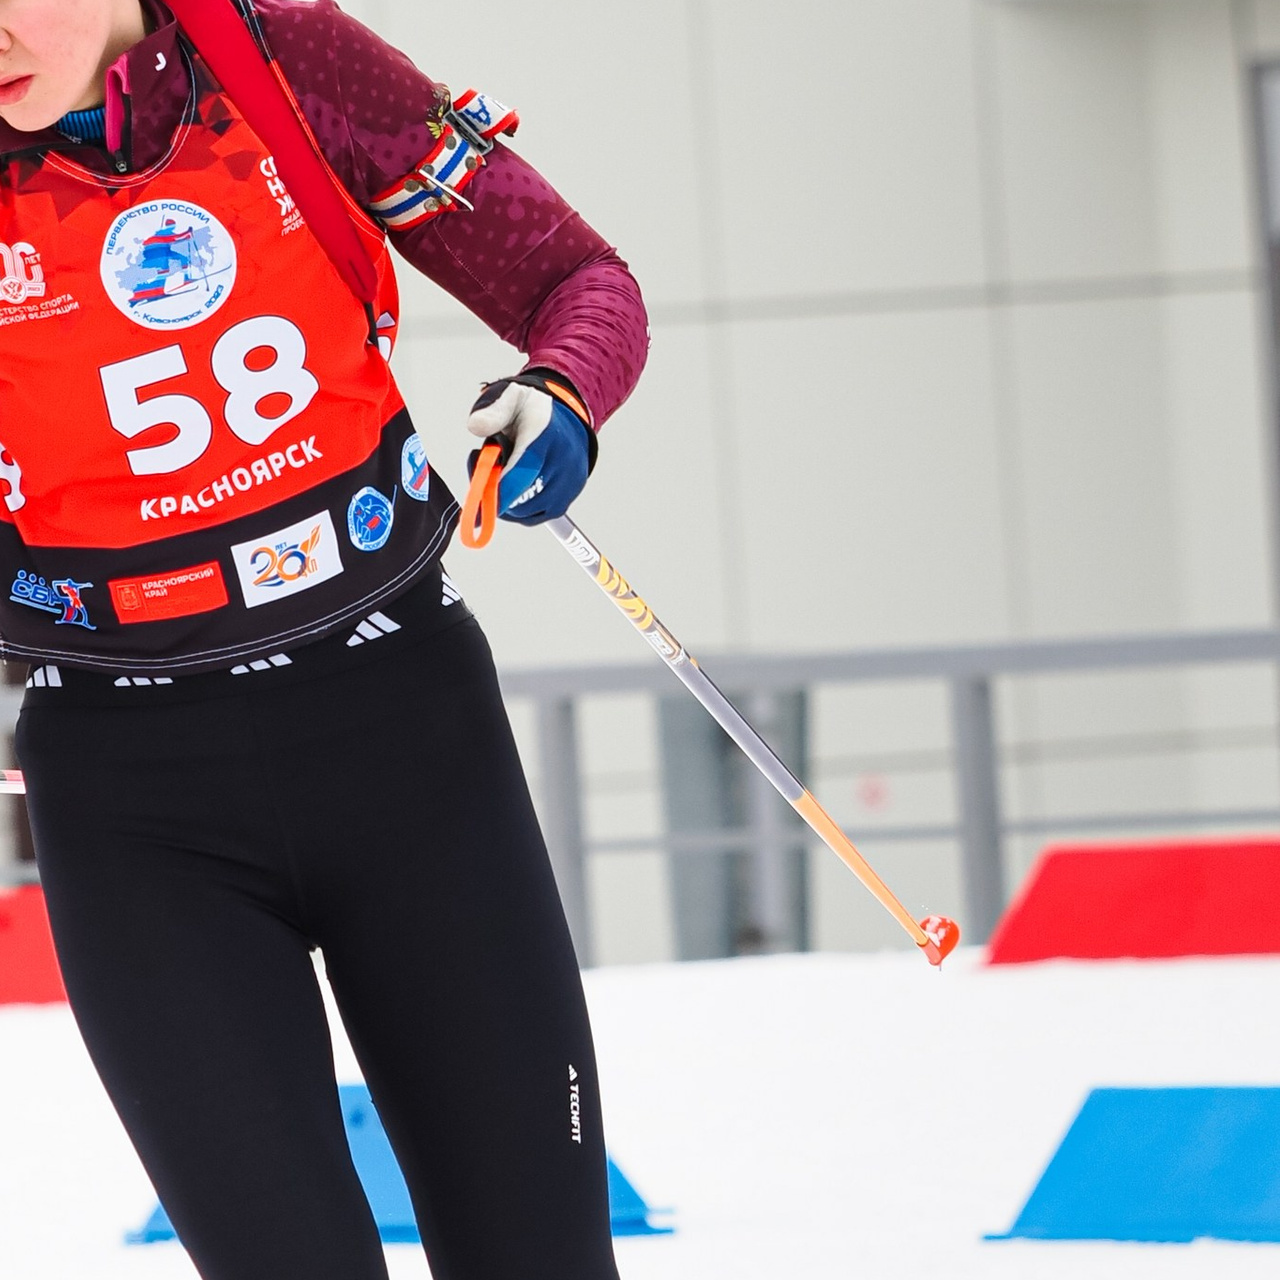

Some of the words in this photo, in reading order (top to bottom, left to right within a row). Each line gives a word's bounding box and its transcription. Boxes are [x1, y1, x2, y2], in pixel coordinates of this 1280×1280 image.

[106, 204, 159, 255] ПЕРВЕНСТВО
[161, 203, 210, 224] РОССИИ
[24, 253, 41, 265] ЛЕТ
[40, 293, 73, 310] СПОРТА
[204, 284, 224, 308] 2023
[28, 301, 80, 320] ФЕДЕРАЦИИ
[98, 314, 320, 476] 58
[140, 435, 323, 521] КРАСНОЯРСК
[250, 545, 307, 587] 20
[142, 567, 215, 591] КРАСНОЯРСКИЙ
[144, 587, 168, 599] КРАЙ
[569, 1083, 581, 1144] TECHFIT
